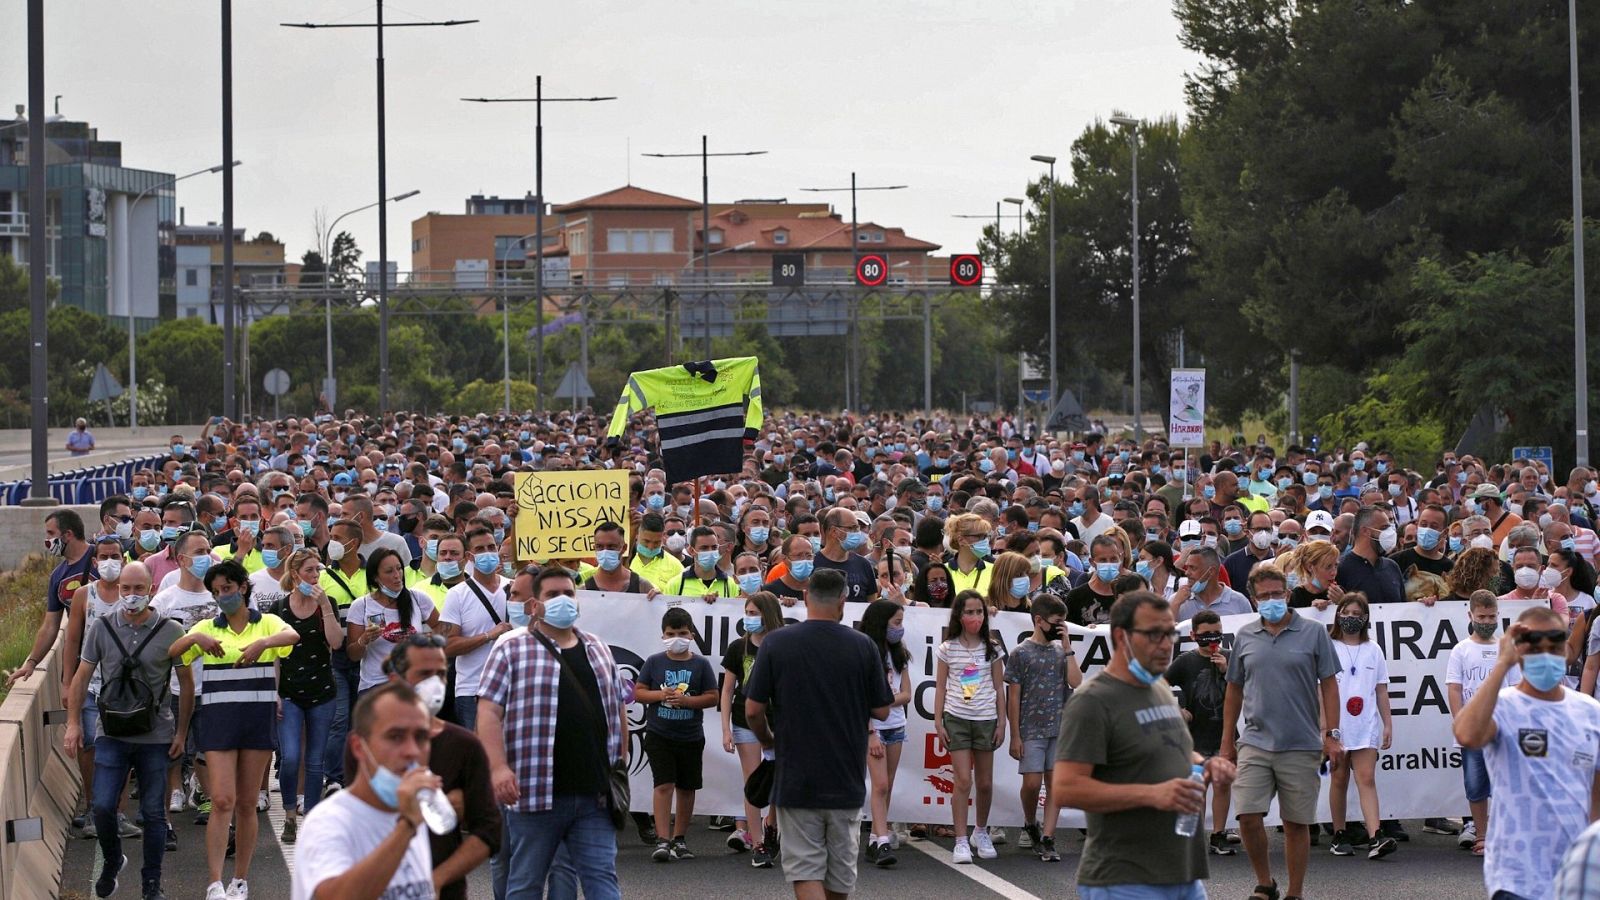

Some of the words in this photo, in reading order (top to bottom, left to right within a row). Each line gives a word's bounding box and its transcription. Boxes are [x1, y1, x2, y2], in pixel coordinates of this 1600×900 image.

[781, 264, 796, 277] 80
[864, 264, 879, 277] 80
[959, 264, 974, 277] 80
[518, 537, 541, 556] NO
[548, 536, 566, 553] SE
